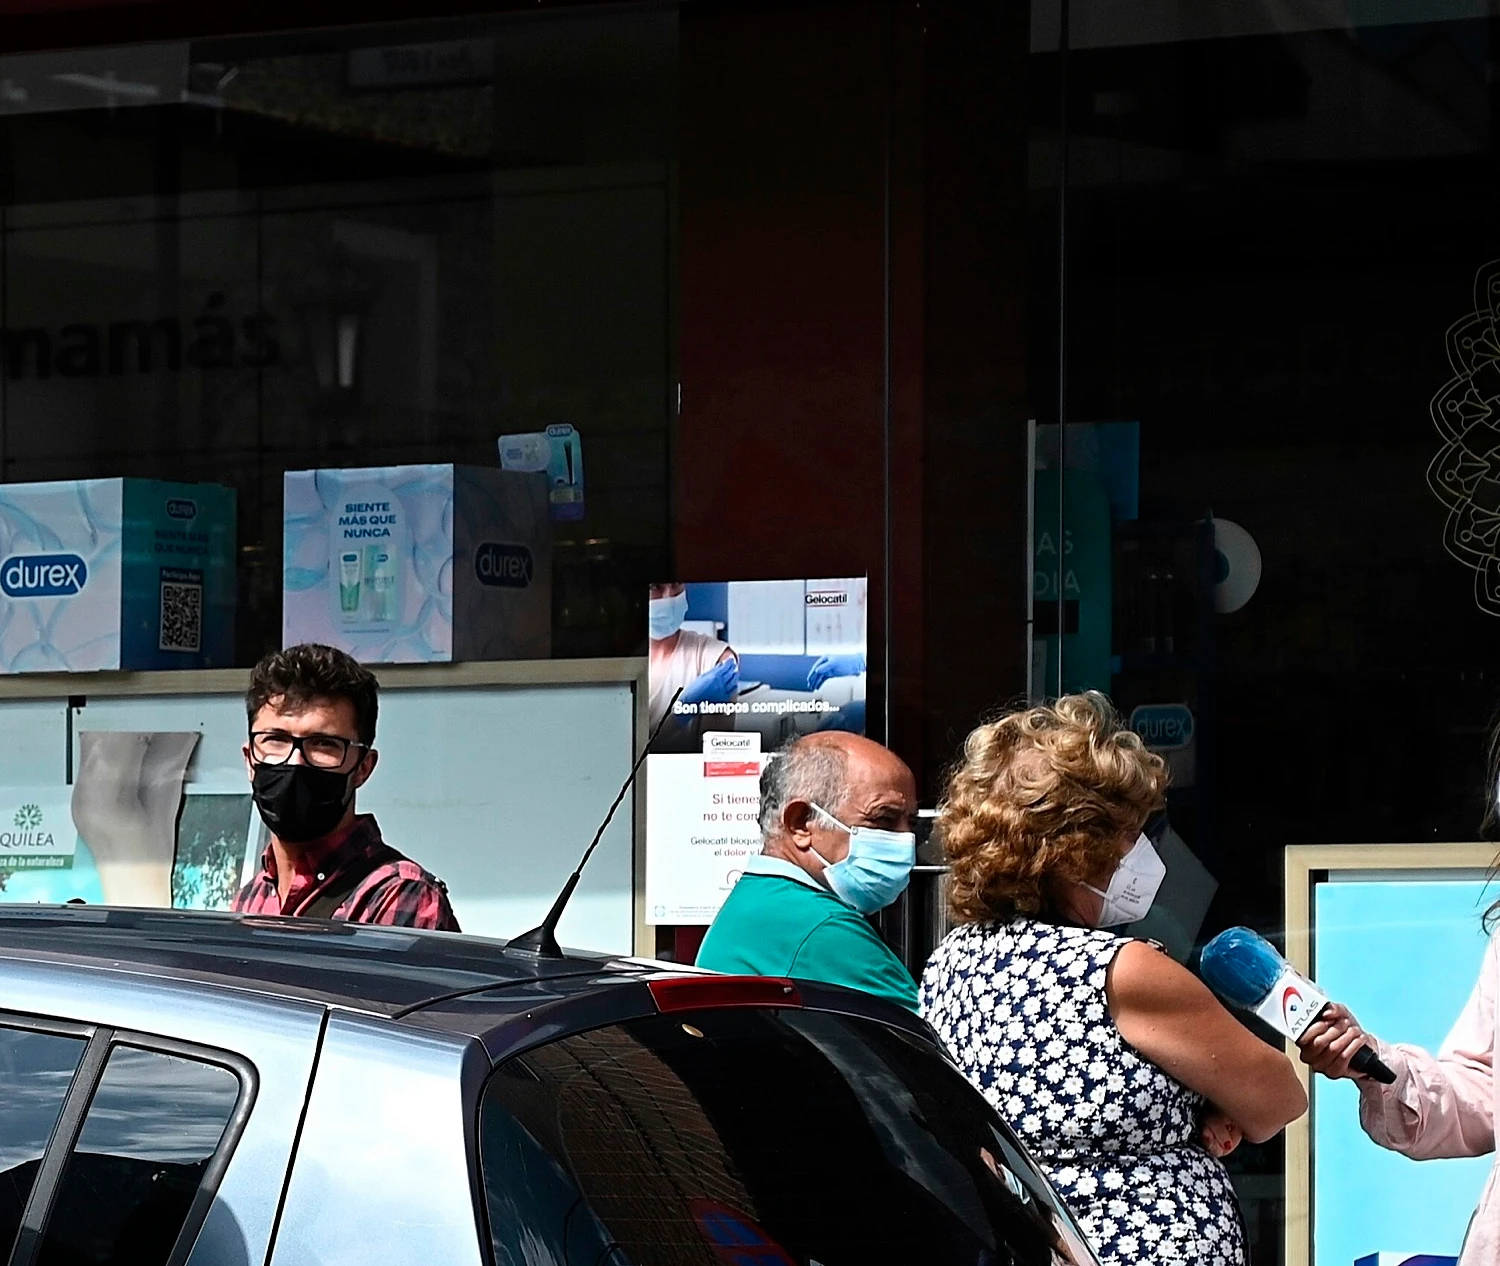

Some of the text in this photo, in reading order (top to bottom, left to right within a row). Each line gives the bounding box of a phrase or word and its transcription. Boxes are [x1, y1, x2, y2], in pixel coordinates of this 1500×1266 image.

[346, 502, 390, 512] SIENTE
[339, 513, 396, 526] MÁS QUE
[344, 528, 391, 538] NUNCA
[480, 547, 530, 584] durex
[6, 560, 81, 591] durex
[804, 593, 848, 605] Gelocatil
[673, 700, 698, 715] Son
[701, 700, 750, 717] tiempos
[1136, 712, 1187, 738] durex
[711, 738, 751, 748] Gelocatil
[713, 793, 724, 805] Si
[703, 812, 718, 822] no
[722, 811, 732, 822] te
[690, 836, 728, 846] Gelocatil
[714, 848, 722, 857] el
[724, 848, 747, 857] dolor
[1291, 1000, 1320, 1035] ATLAS
